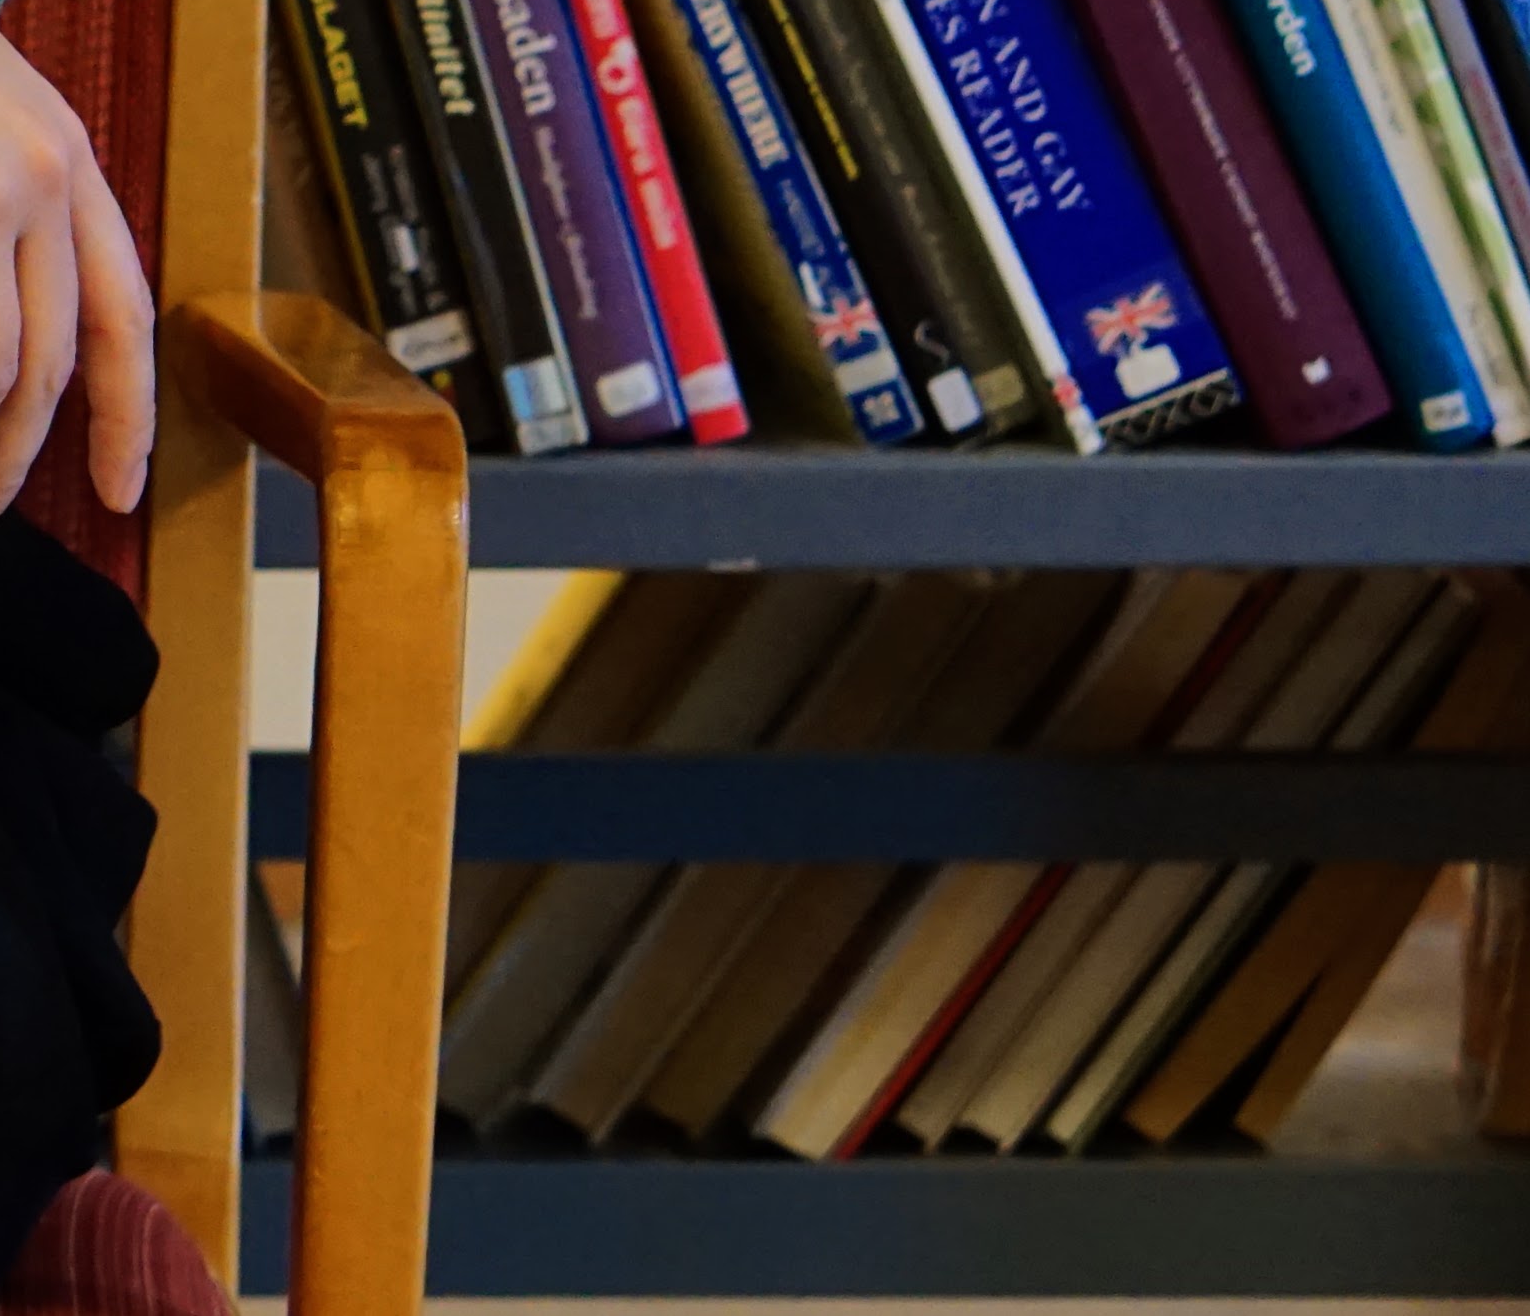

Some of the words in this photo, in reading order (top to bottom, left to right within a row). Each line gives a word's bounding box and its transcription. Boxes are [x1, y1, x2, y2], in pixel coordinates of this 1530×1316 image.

[941, 43, 1051, 221] READER
[982, 27, 1056, 131] AND
[1025, 125, 1095, 223] GAY
